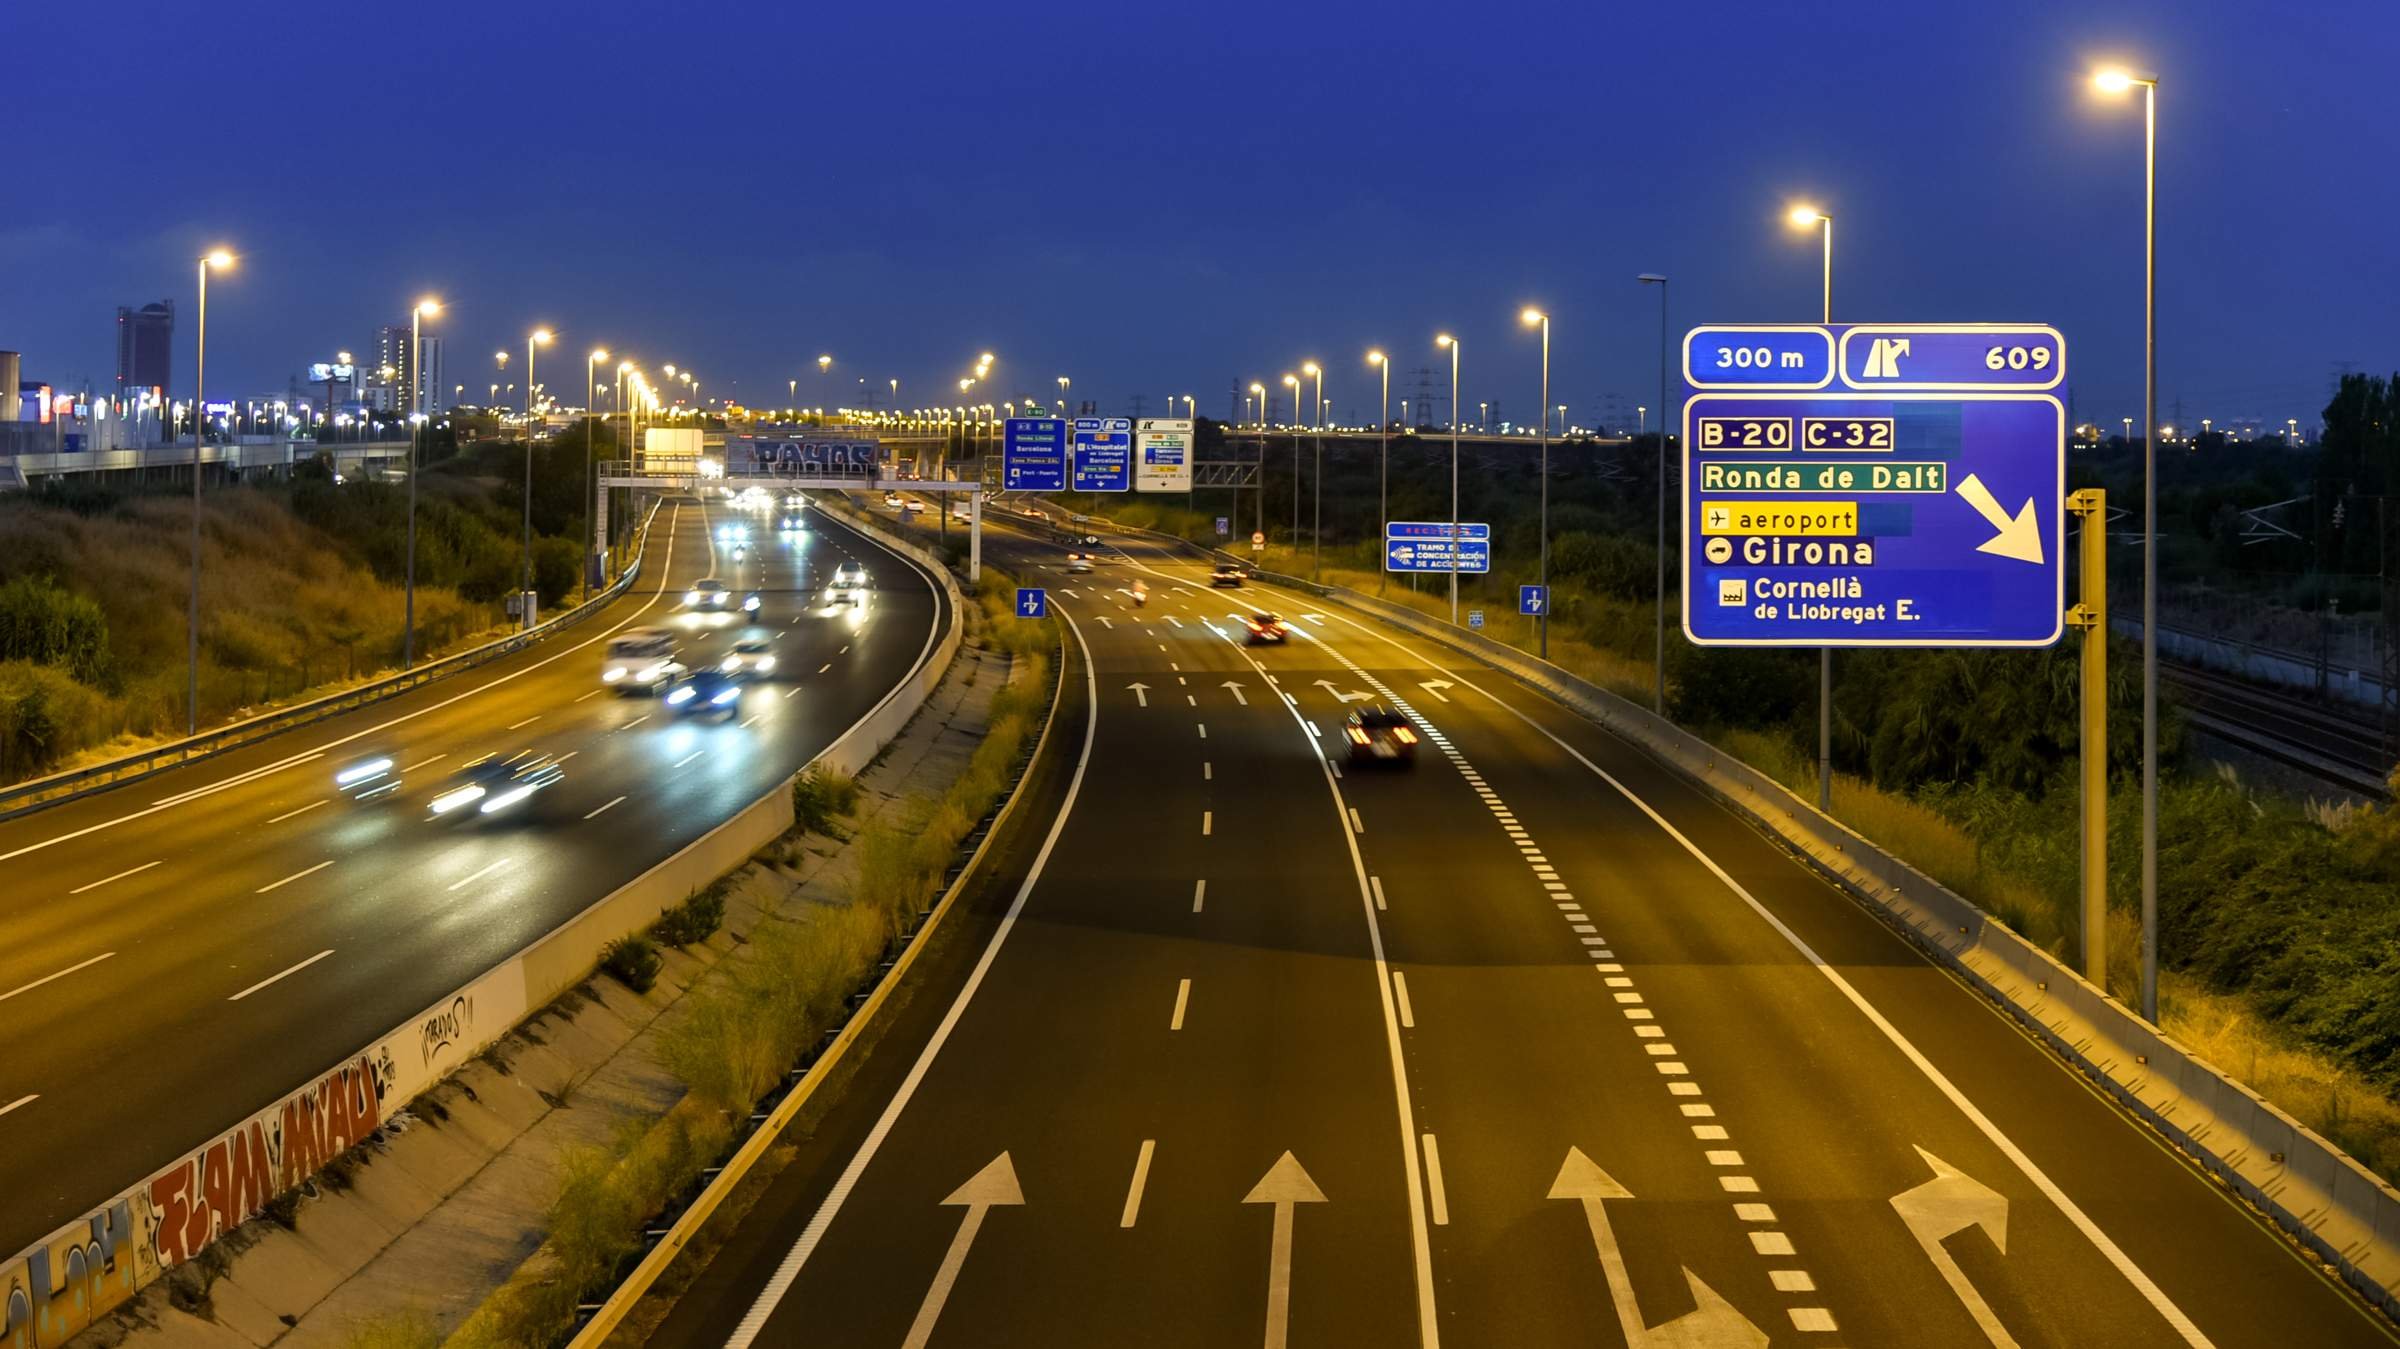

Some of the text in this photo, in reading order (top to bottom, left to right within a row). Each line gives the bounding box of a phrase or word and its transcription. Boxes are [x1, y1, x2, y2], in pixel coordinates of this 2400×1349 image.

[1716, 347, 1803, 368] 300 m
[1985, 346, 2051, 371] 609
[1704, 423, 1787, 446] B-20
[1807, 422, 1889, 446] C-32
[1705, 465, 1939, 489] Ronda de Dalt
[1739, 509, 1853, 534] aeroport
[1743, 536, 1873, 565] Girona
[1754, 576, 1862, 598] Cornellà
[1754, 600, 1921, 624] de Llobregat E.
